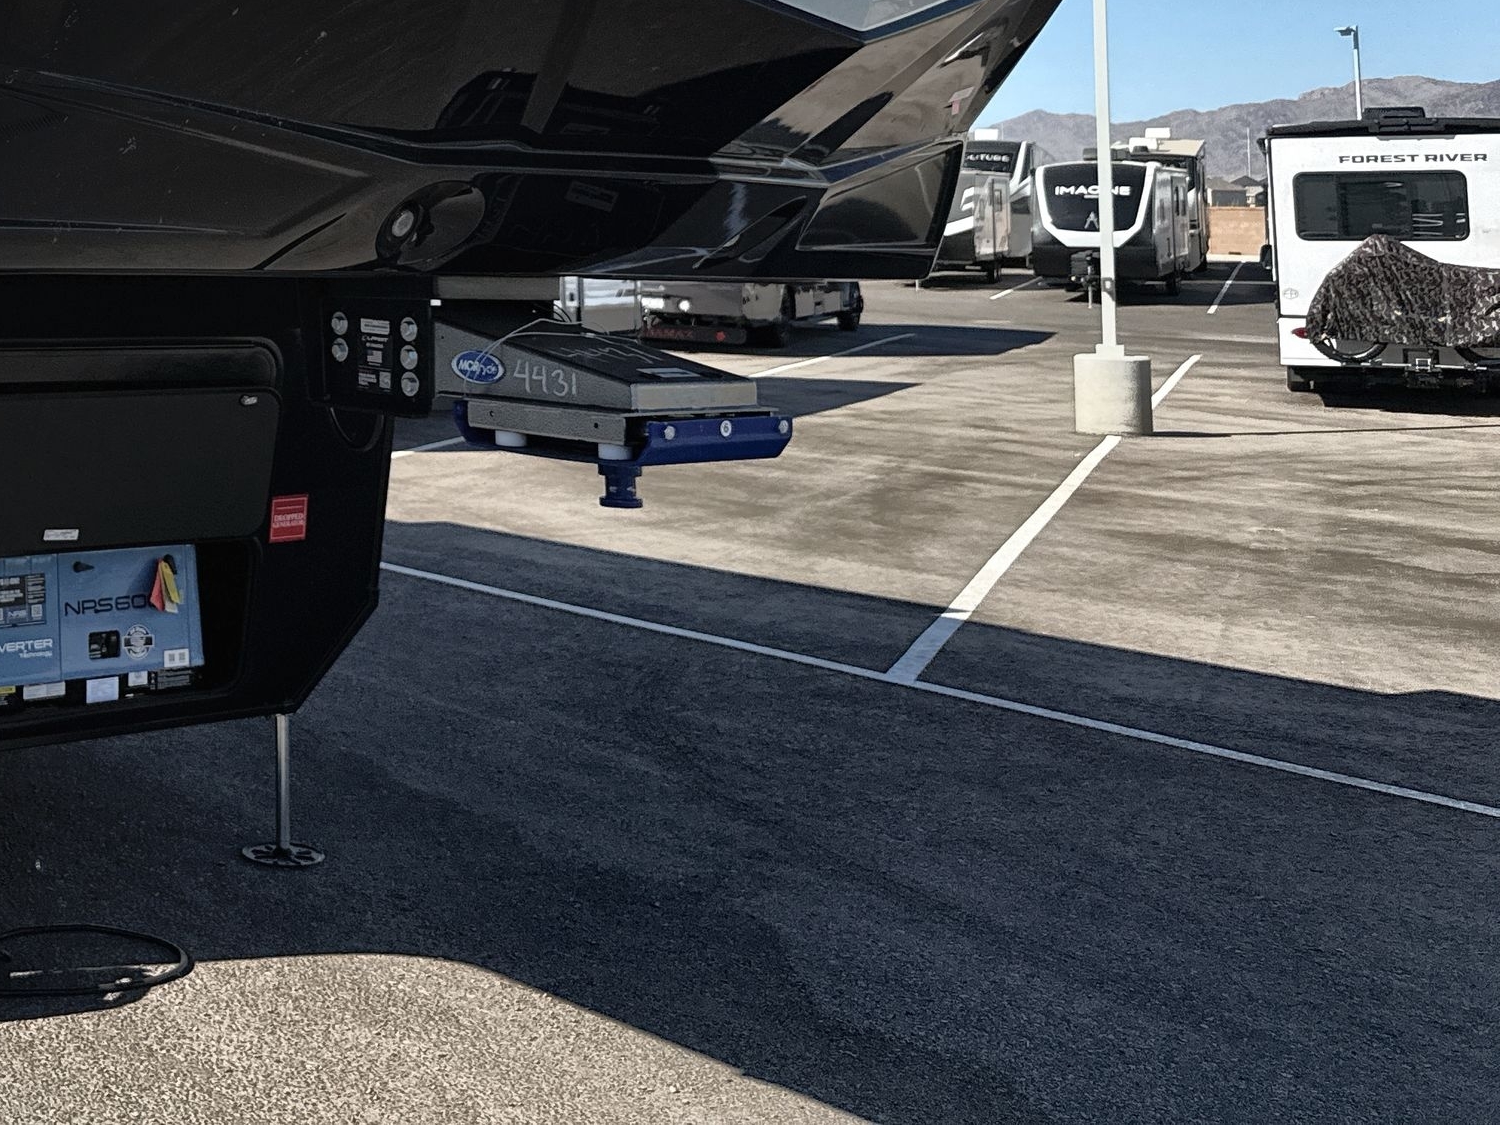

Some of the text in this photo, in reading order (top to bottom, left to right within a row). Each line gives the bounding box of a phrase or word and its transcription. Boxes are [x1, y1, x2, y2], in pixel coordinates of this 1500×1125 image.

[1338, 153, 1488, 164] FOREST RIVER
[1054, 185, 1131, 196] IMAGNE
[513, 359, 577, 397] 4431
